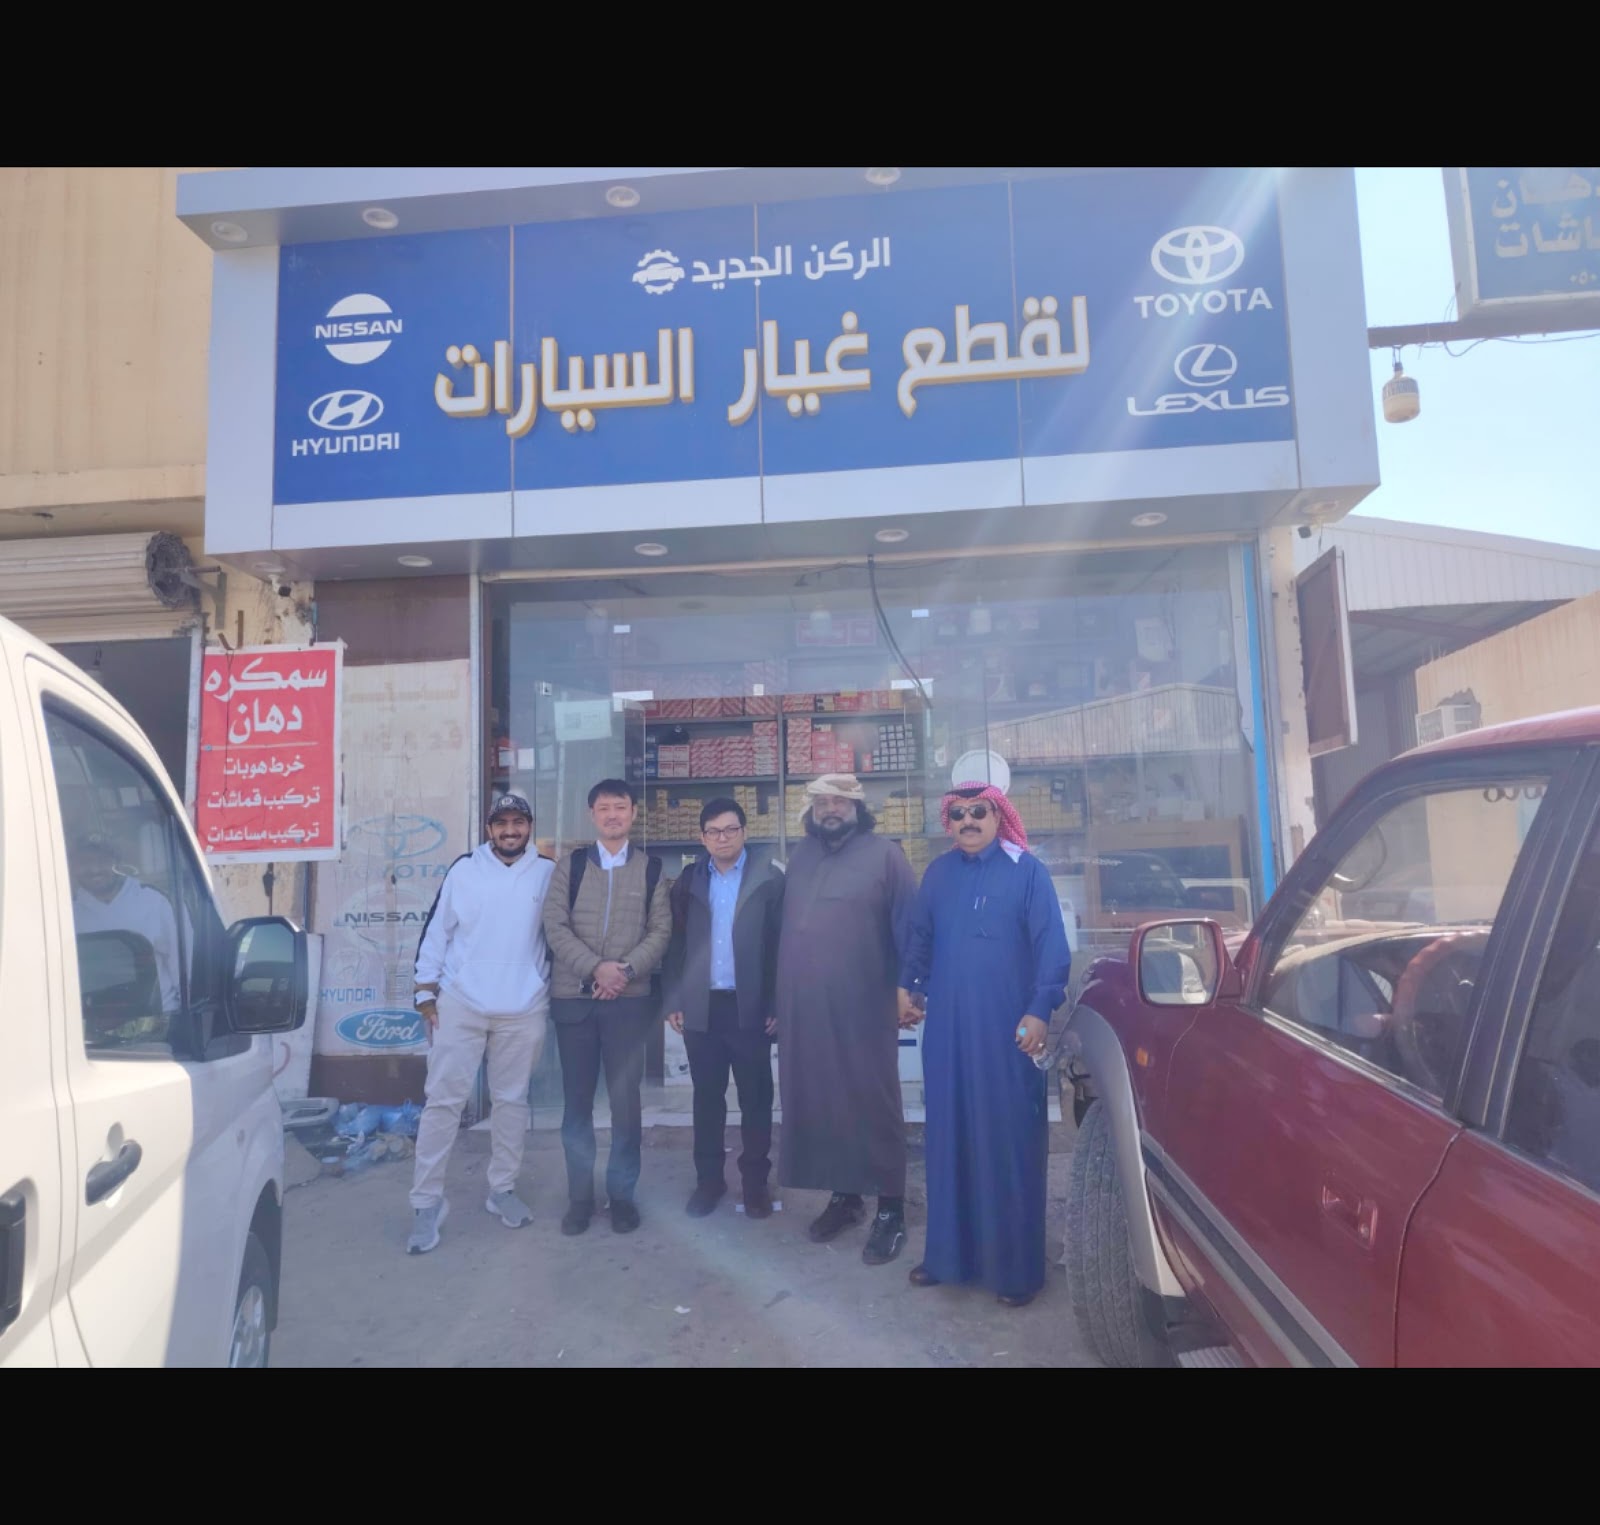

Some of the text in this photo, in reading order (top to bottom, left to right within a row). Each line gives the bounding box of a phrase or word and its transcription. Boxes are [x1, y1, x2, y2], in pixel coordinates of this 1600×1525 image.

[1491, 173, 1600, 218] هان
[1496, 213, 1600, 258] اشات
[691, 236, 891, 290] الركن الجديد
[1133, 287, 1273, 319] TOYOTA
[315, 319, 403, 339] NISSAN
[434, 294, 1091, 438] لقطع غيار السيارات
[1126, 385, 1290, 416] LEXUS
[292, 432, 400, 457] HYUNDAI
[204, 656, 328, 702] سمكره
[227, 698, 303, 744] دهان
[269, 754, 305, 777] خرط
[207, 786, 321, 810] تركيب قماشات
[207, 822, 320, 843] تركيب مساعدات
[319, 986, 376, 1003] HYUNDAI
[355, 1012, 421, 1042] Ford
